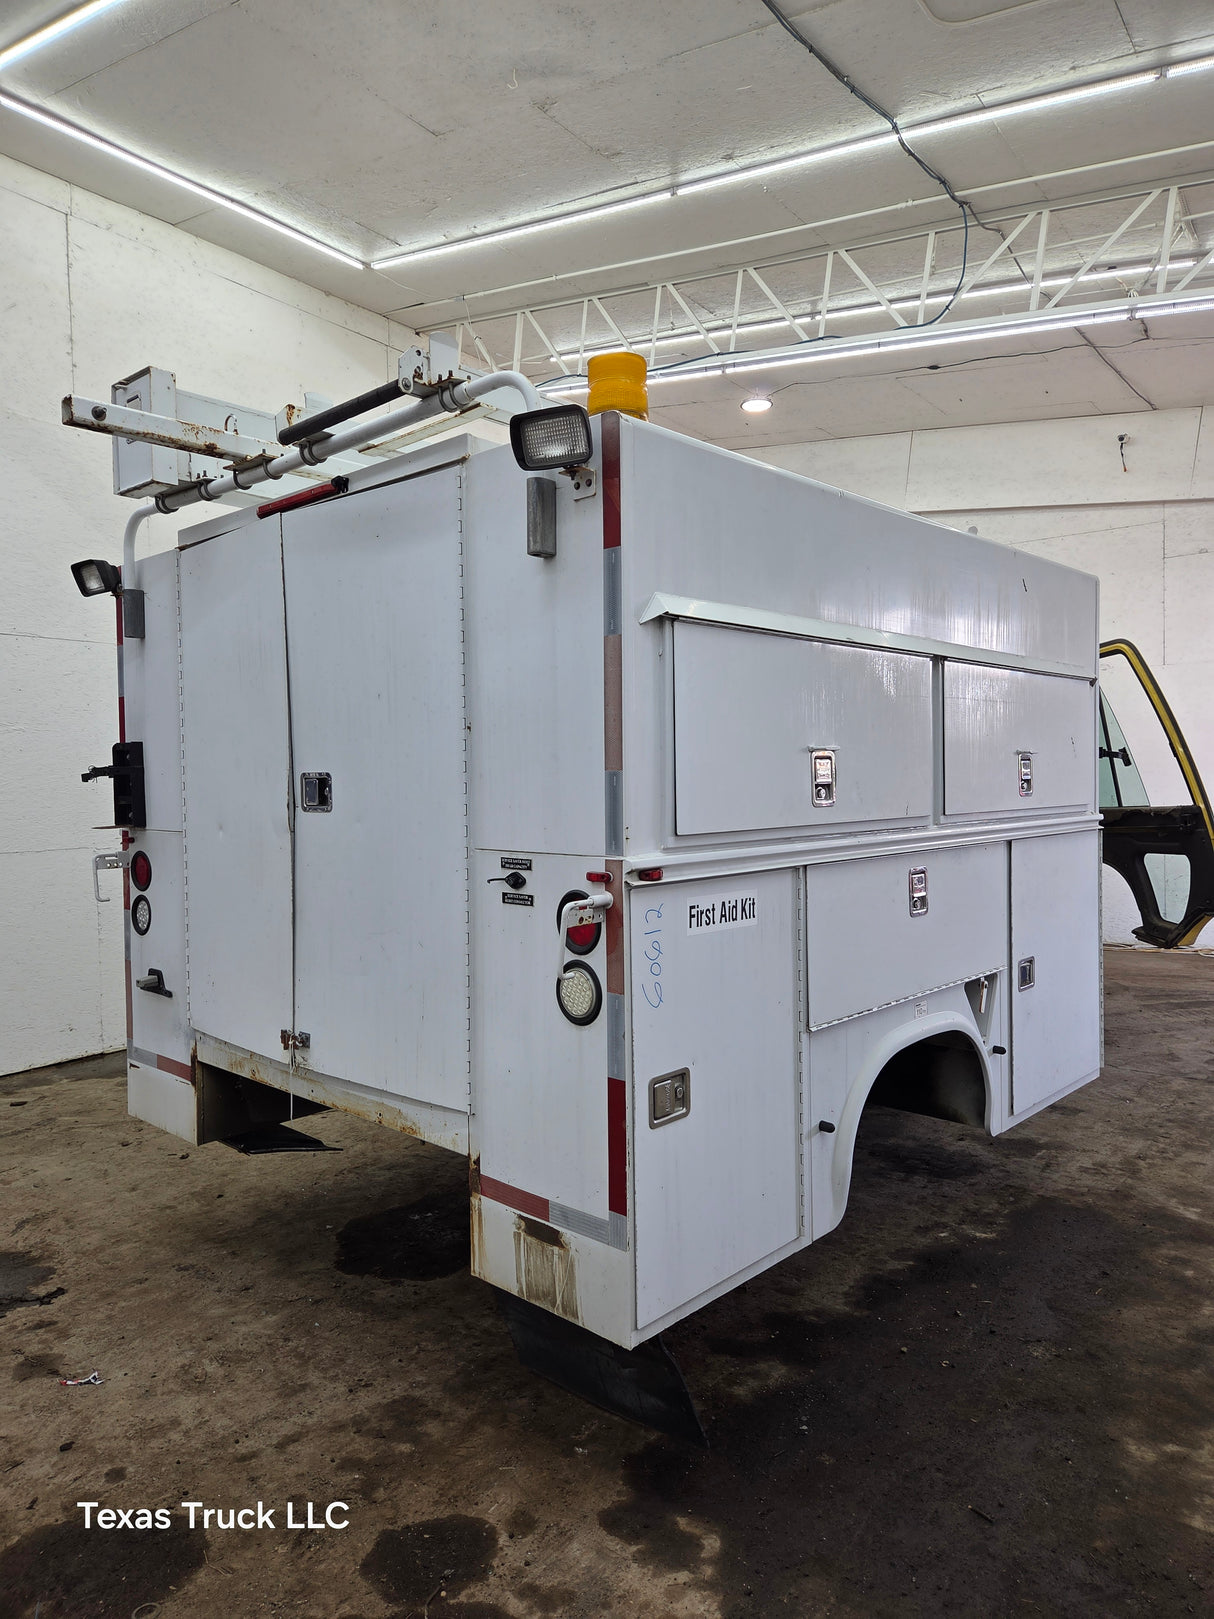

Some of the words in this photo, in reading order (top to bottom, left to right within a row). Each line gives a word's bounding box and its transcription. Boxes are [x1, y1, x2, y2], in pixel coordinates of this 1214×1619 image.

[689, 904, 716, 929] First
[719, 899, 738, 924] Aid
[741, 897, 756, 921] Kit
[641, 902, 665, 1009] 60612
